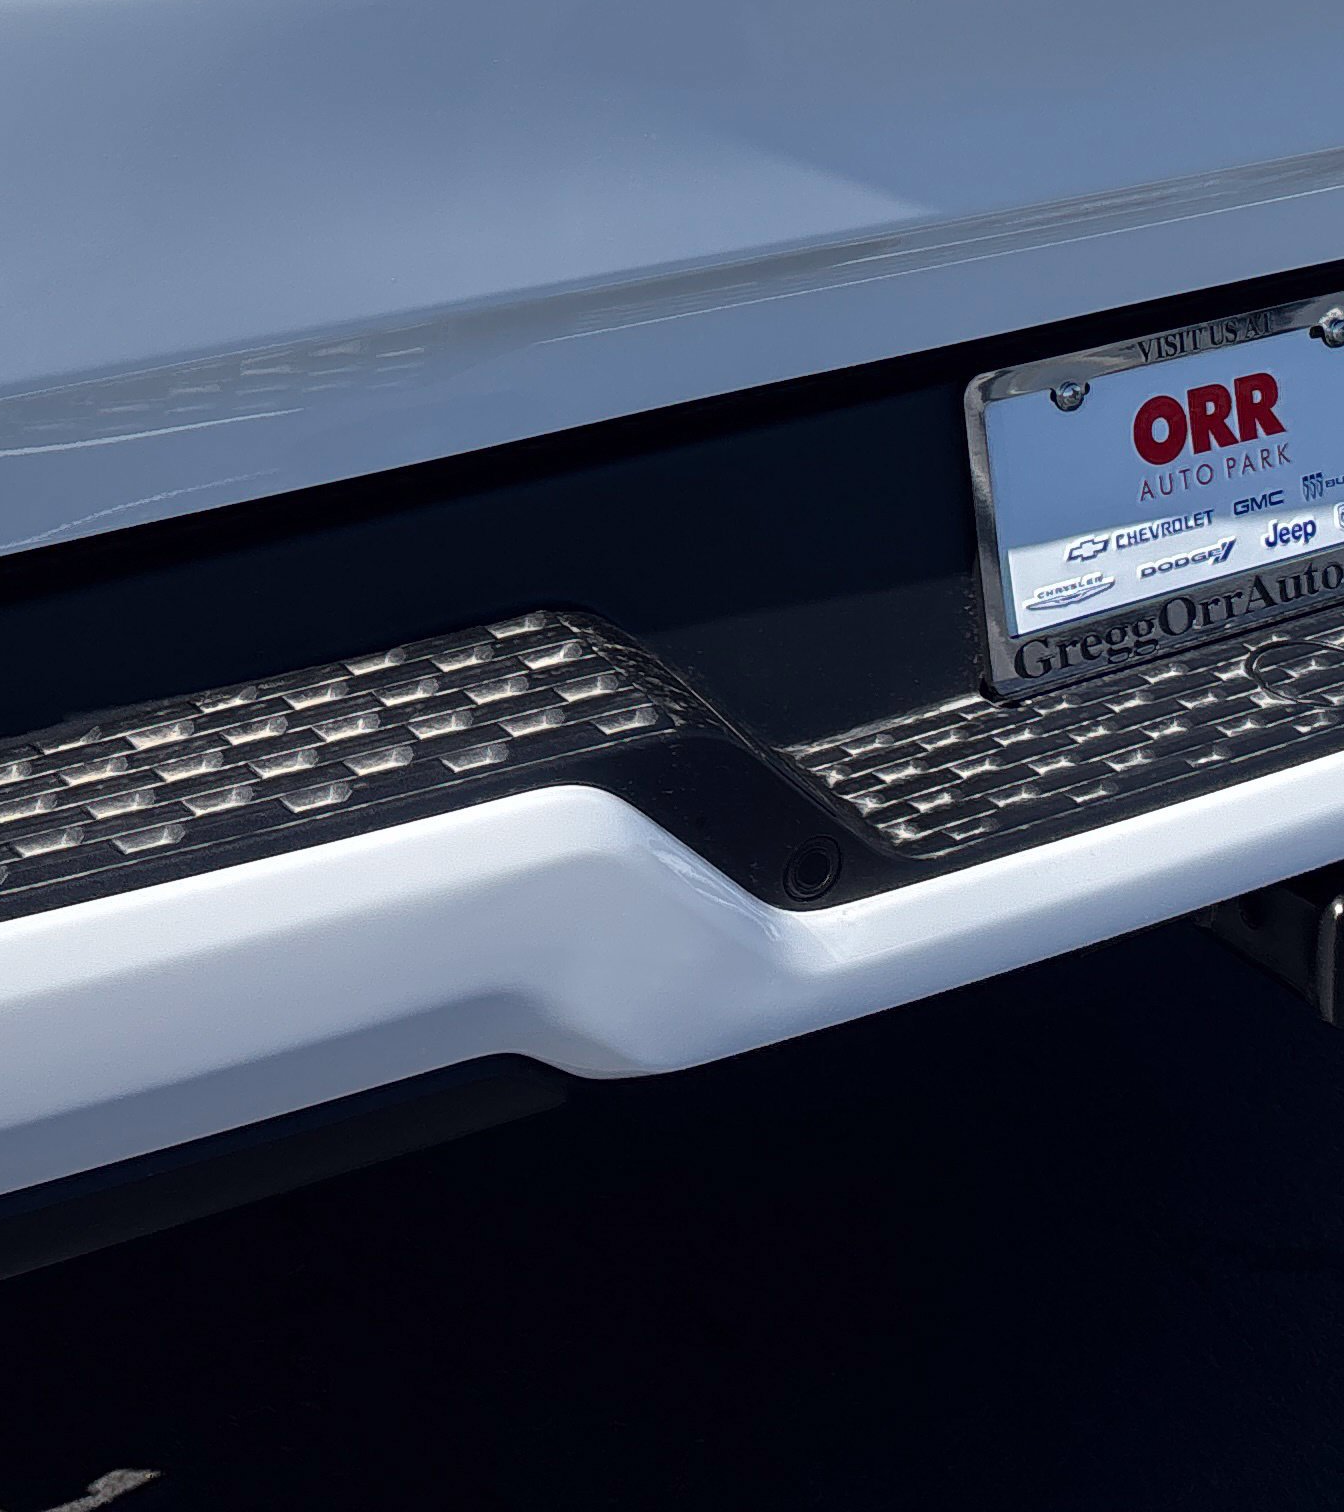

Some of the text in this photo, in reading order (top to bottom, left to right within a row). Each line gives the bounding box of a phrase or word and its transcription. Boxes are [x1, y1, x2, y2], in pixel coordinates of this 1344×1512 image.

[1137, 326, 1205, 363] VISIT
[1208, 319, 1239, 346] US
[1133, 372, 1288, 466] ORR
[1140, 442, 1292, 502] AUTO PARK
[1233, 489, 1285, 516] GMC
[1115, 508, 1215, 550] CHEVROLET
[1264, 518, 1317, 548] Jeep
[1140, 544, 1223, 579] DODGE
[1037, 574, 1104, 600] CHRYSLER
